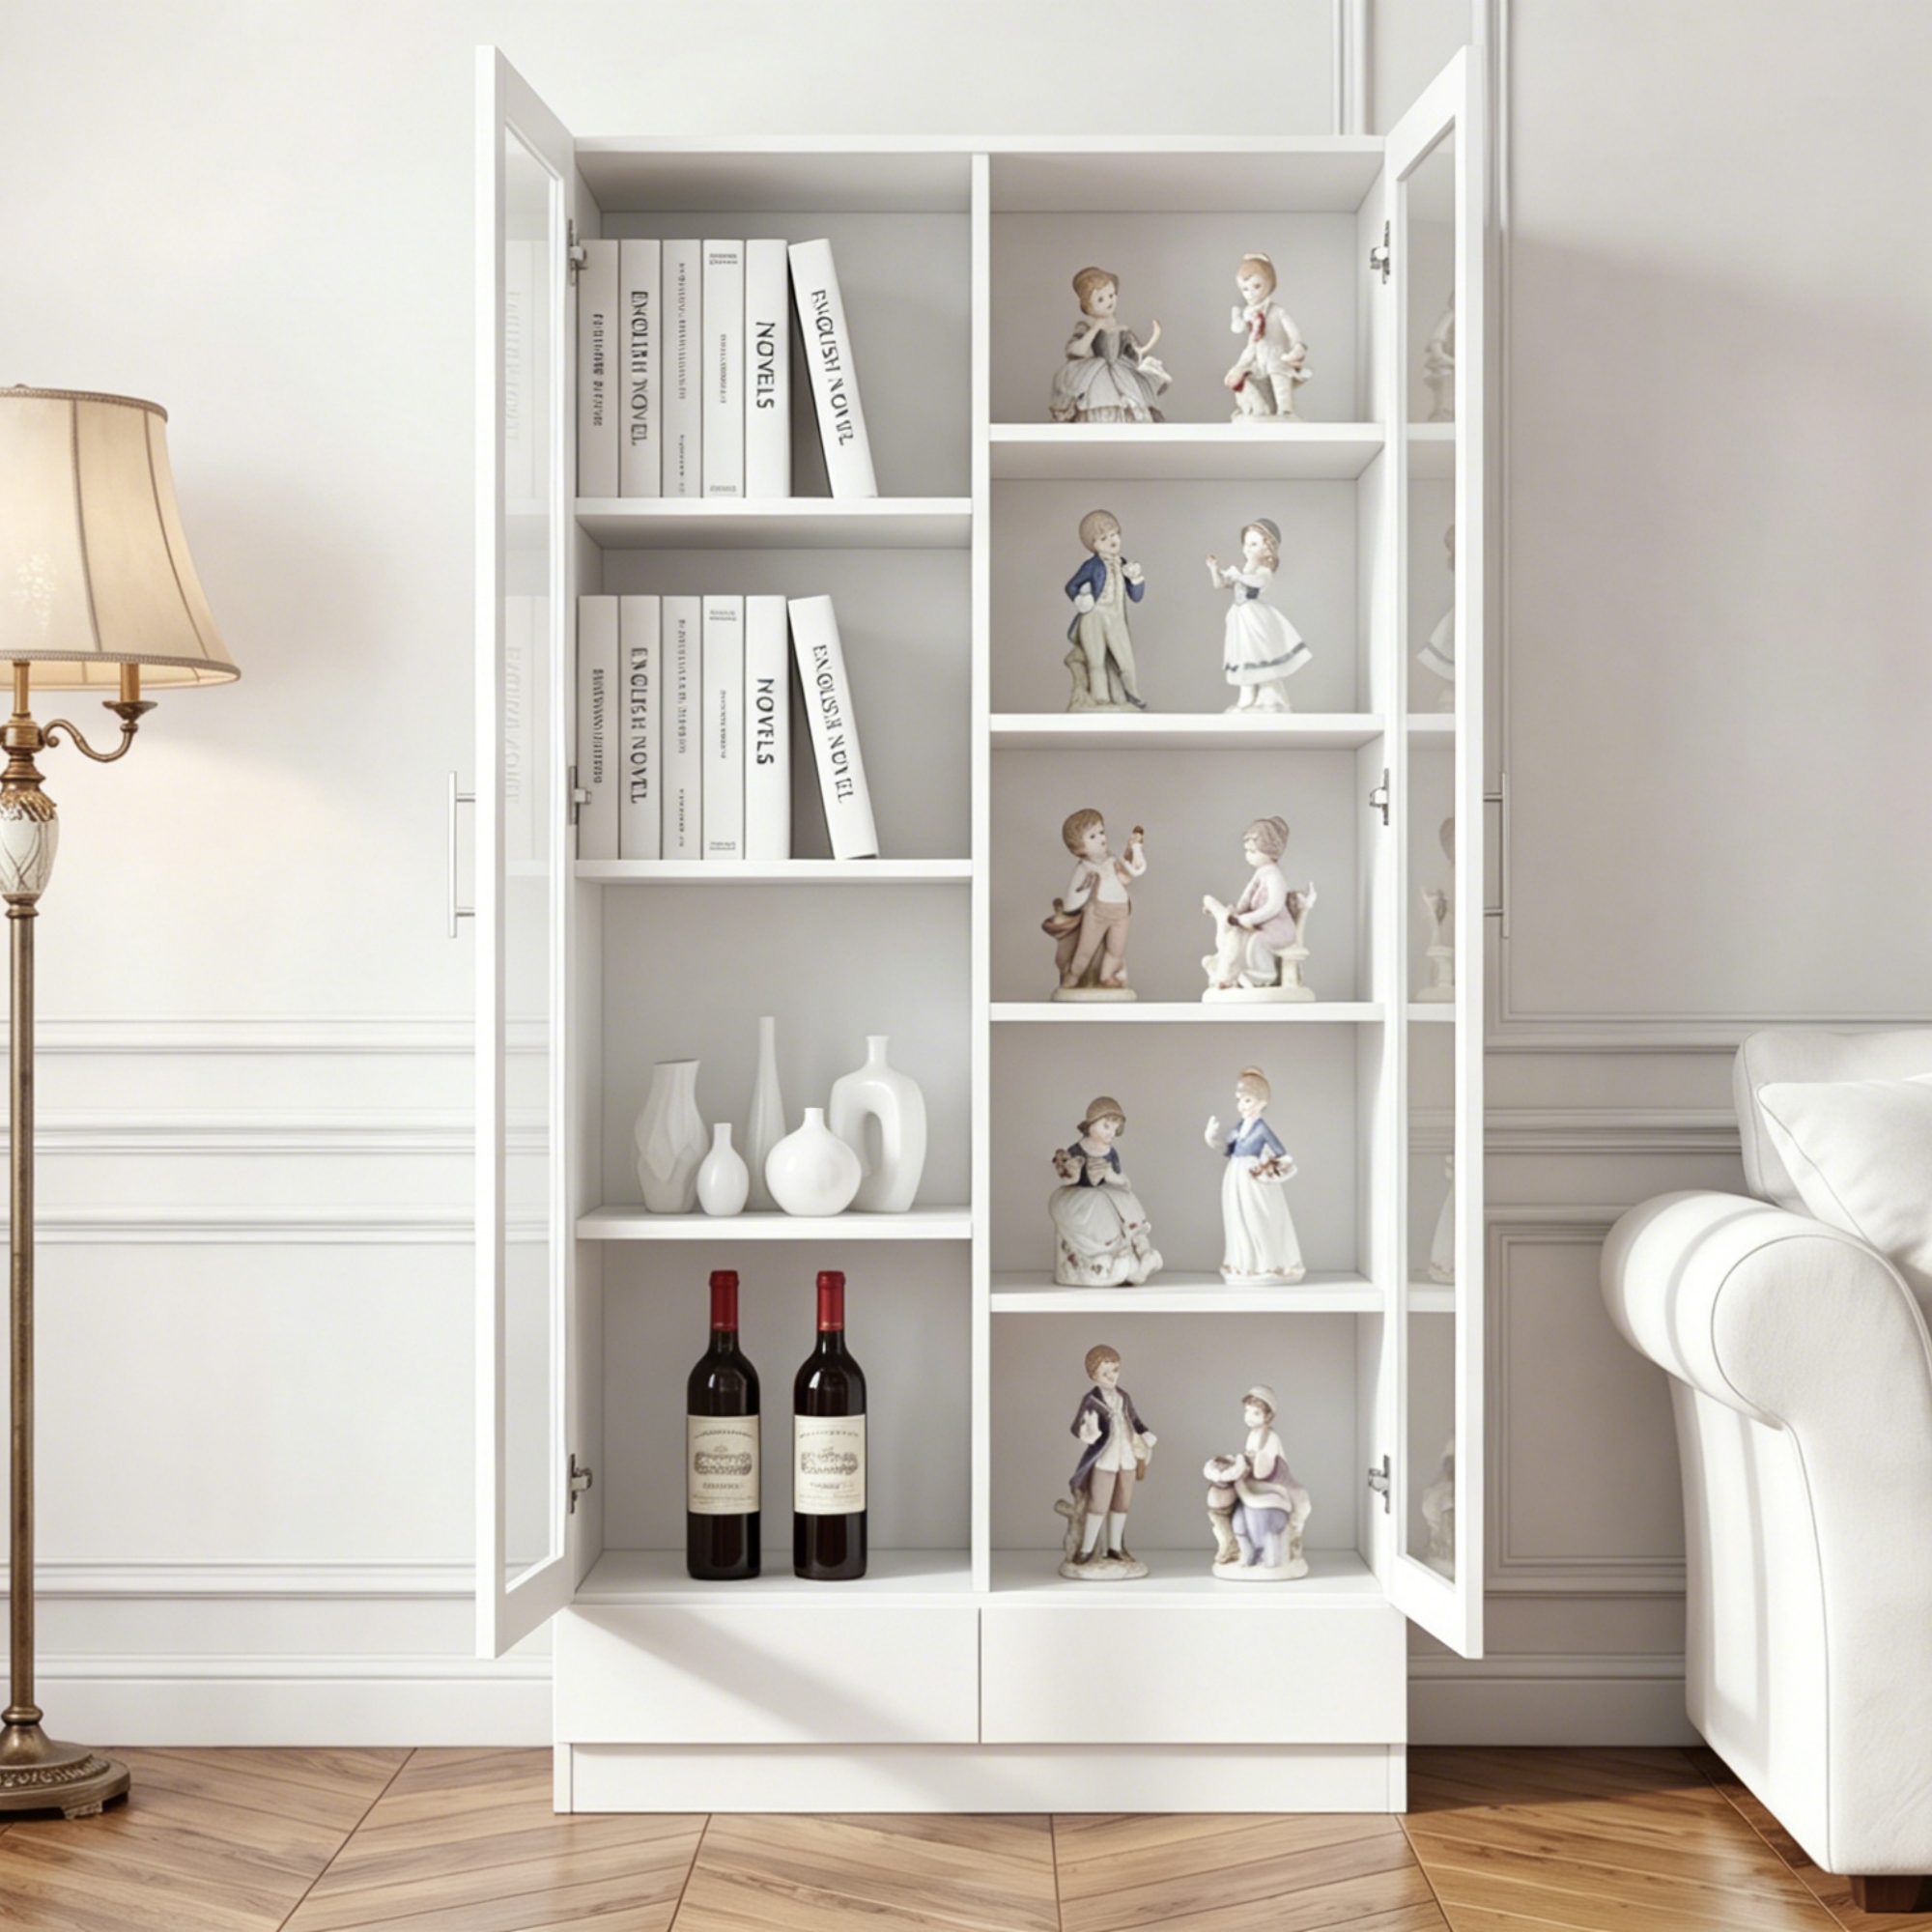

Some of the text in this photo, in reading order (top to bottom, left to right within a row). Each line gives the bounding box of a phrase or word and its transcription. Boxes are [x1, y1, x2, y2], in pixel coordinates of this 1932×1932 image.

[755, 321, 776, 410] NOVELS
[755, 677, 775, 765] NOVELS
[630, 735, 648, 805] NOVEL
